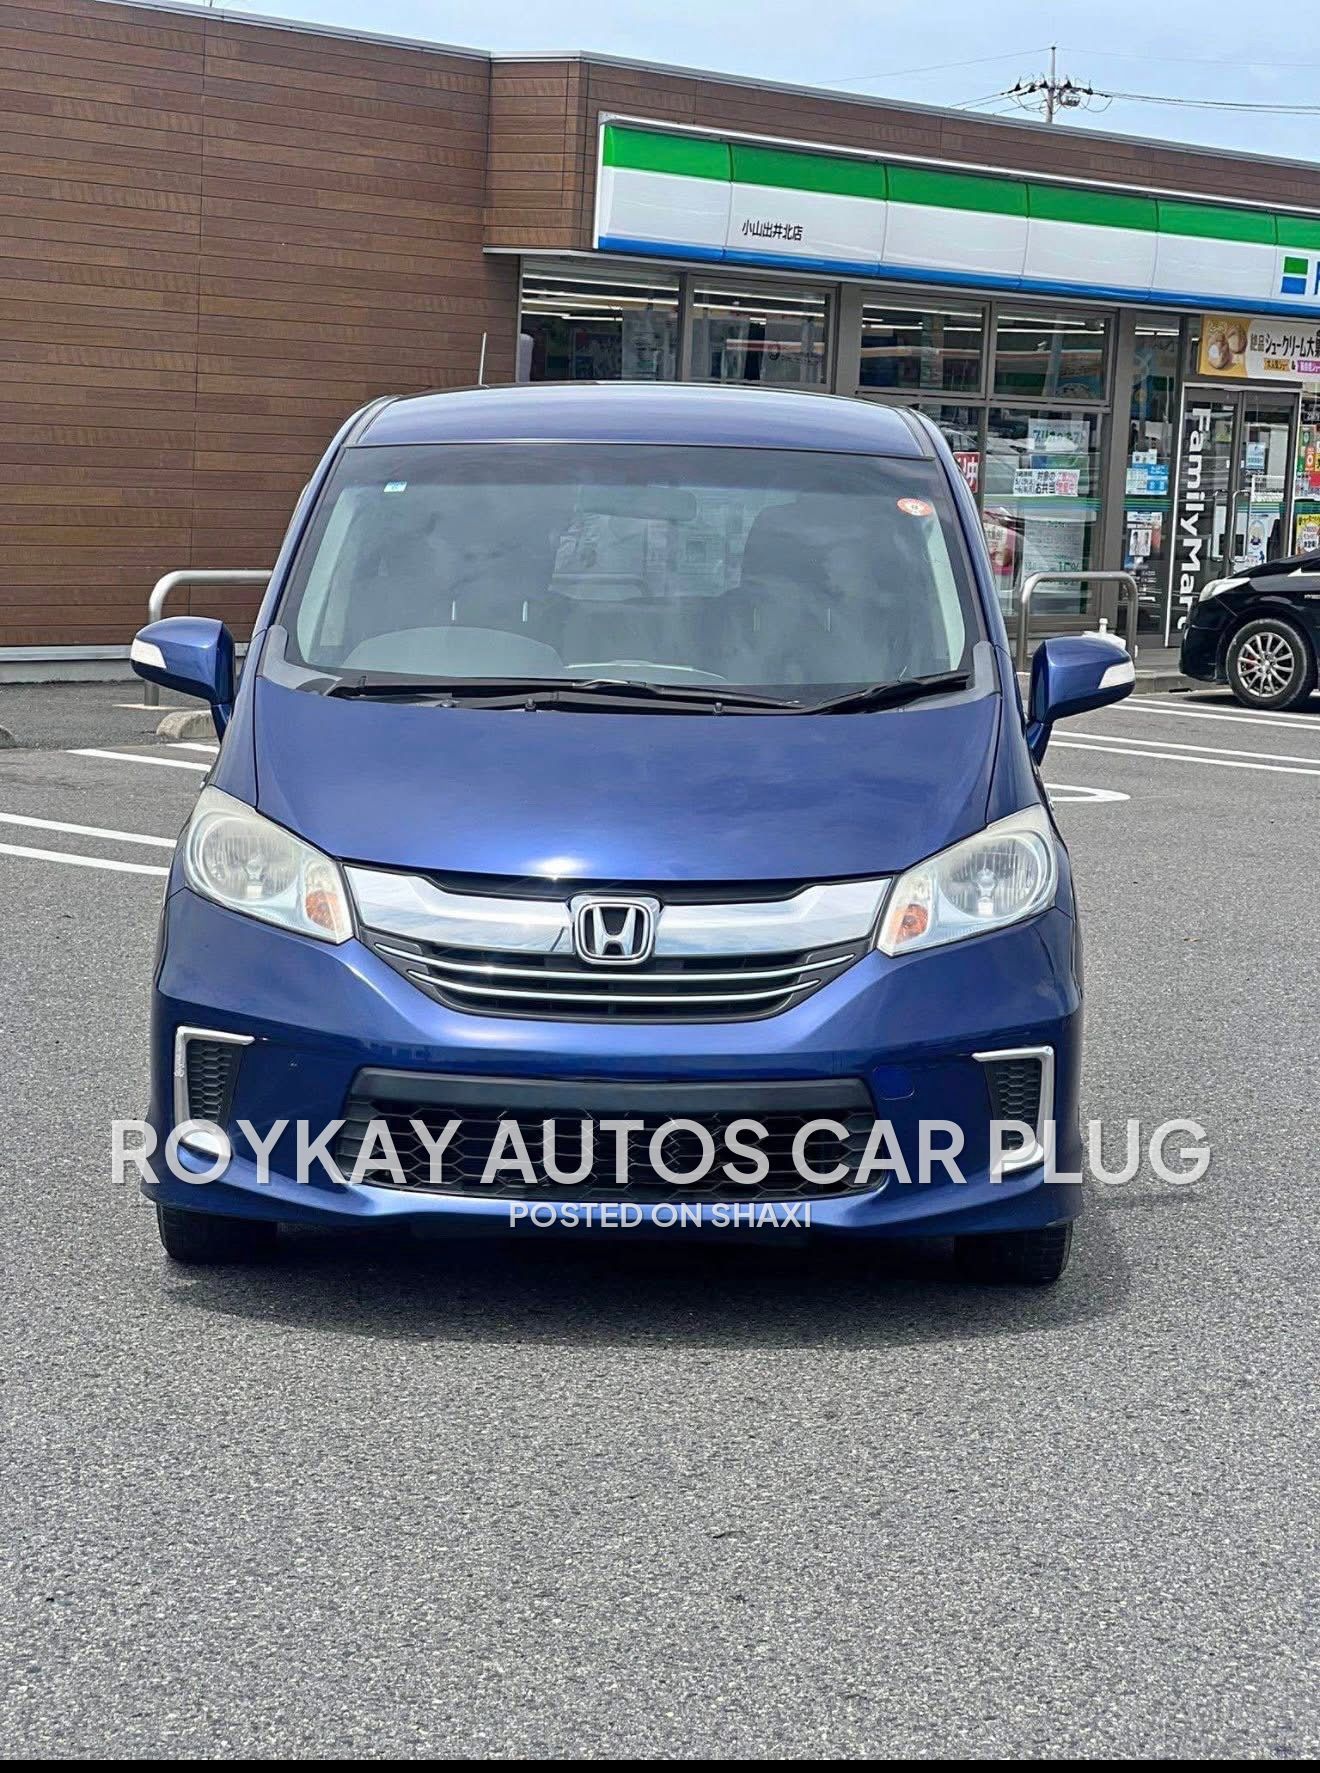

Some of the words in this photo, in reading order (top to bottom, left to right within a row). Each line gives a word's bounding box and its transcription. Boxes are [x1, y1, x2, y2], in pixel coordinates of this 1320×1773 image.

[742, 219, 804, 241] 小山出井北店
